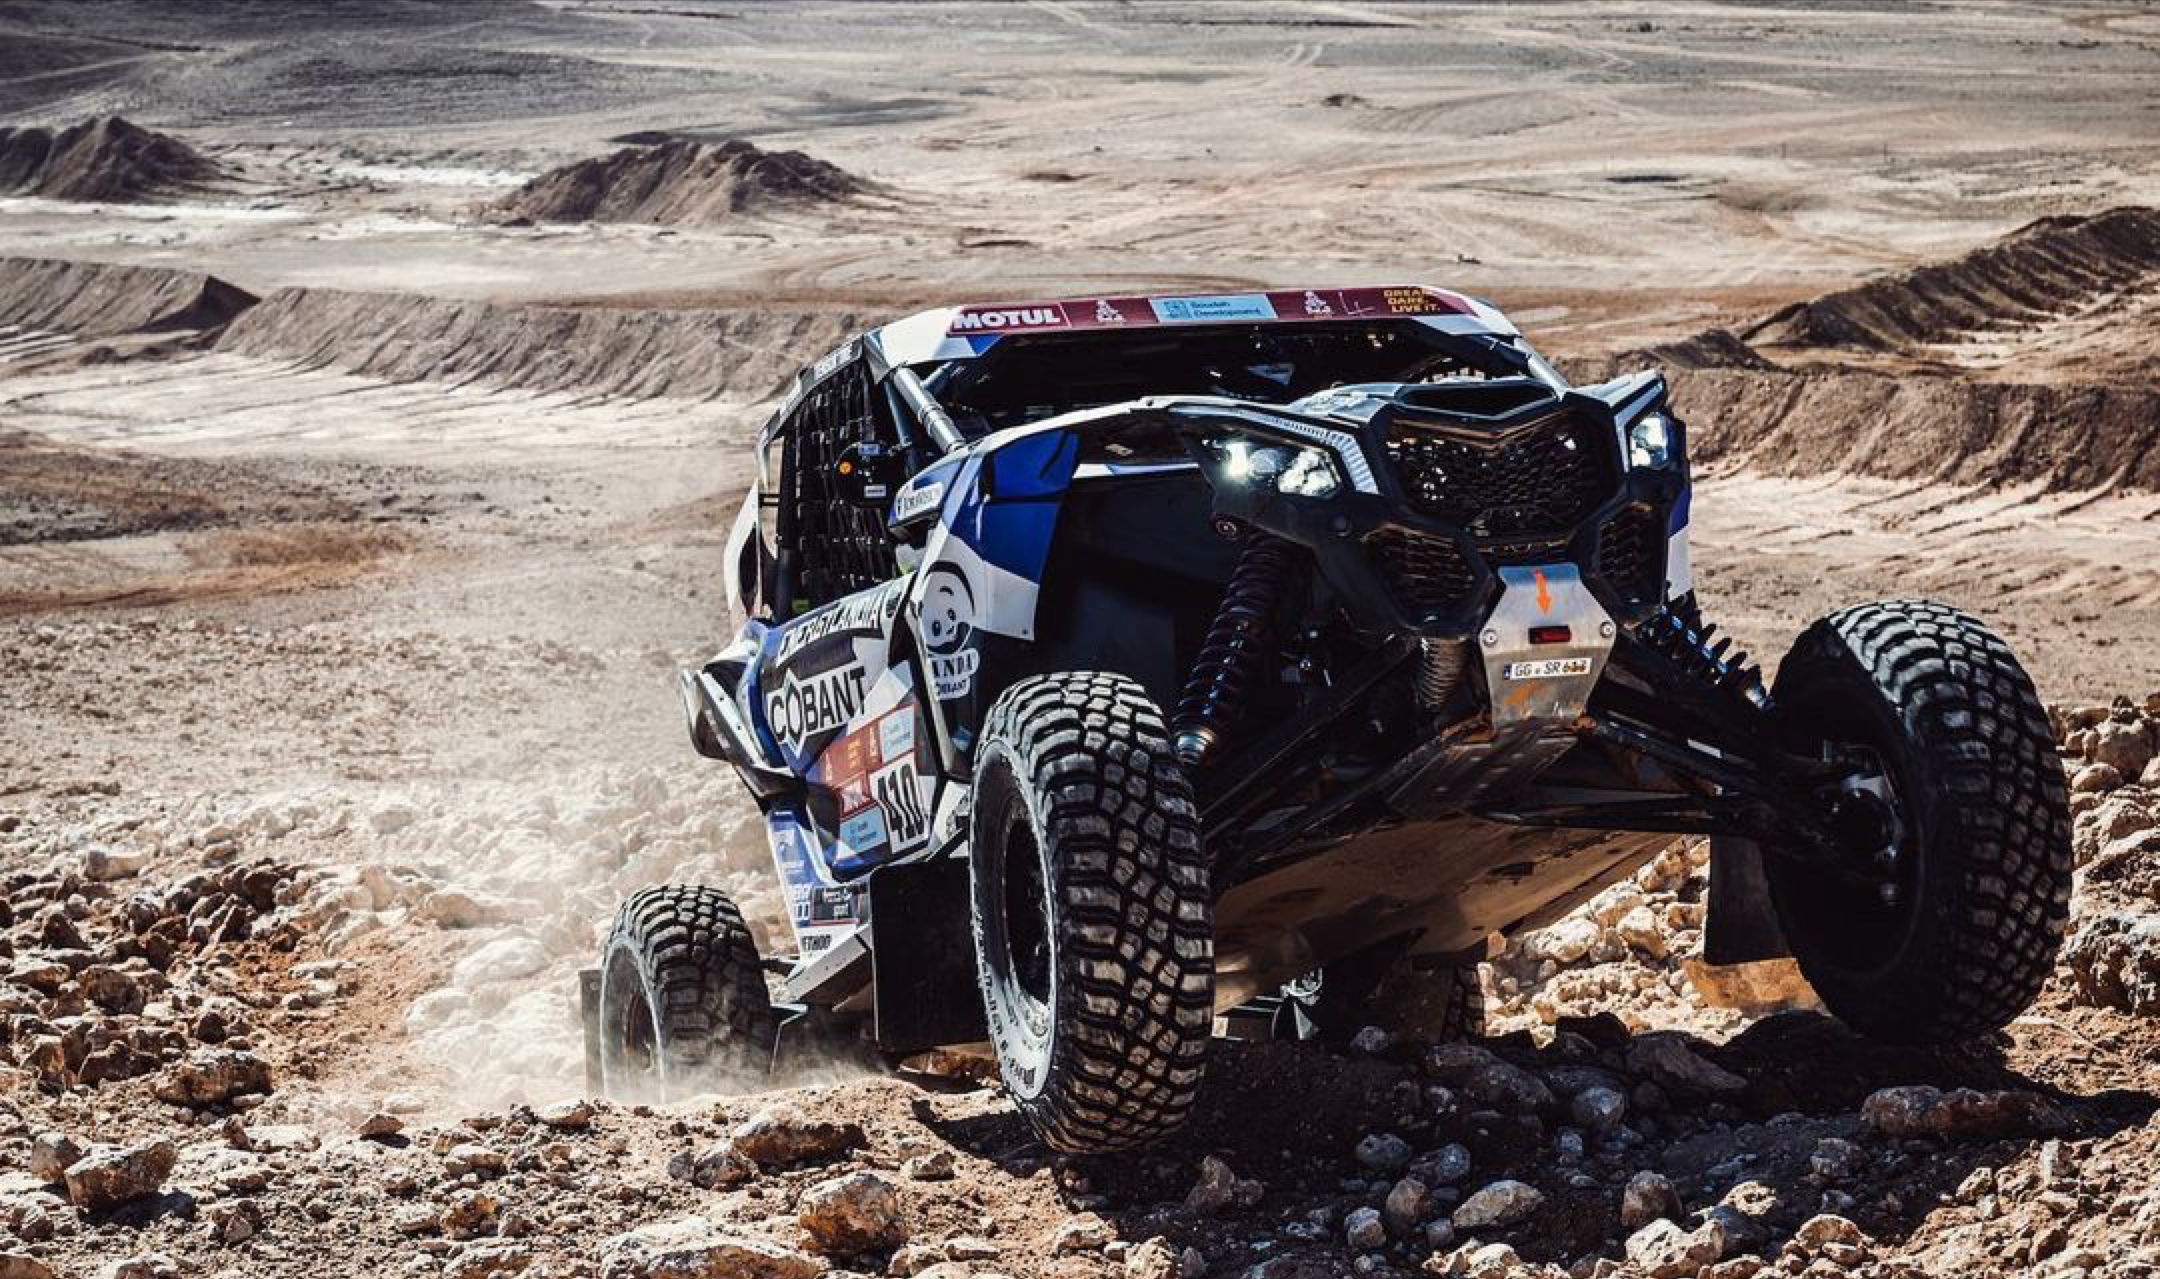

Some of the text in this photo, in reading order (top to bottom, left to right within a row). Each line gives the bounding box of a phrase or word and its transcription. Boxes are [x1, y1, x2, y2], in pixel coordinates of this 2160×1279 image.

[953, 309, 1060, 328] MOTUL
[1391, 305, 1422, 313] LIVE
[931, 653, 974, 678] ANDA
[1515, 662, 1533, 677] GG
[1543, 661, 1561, 675] SR
[770, 667, 866, 742] COBANT
[877, 764, 925, 842] 410
